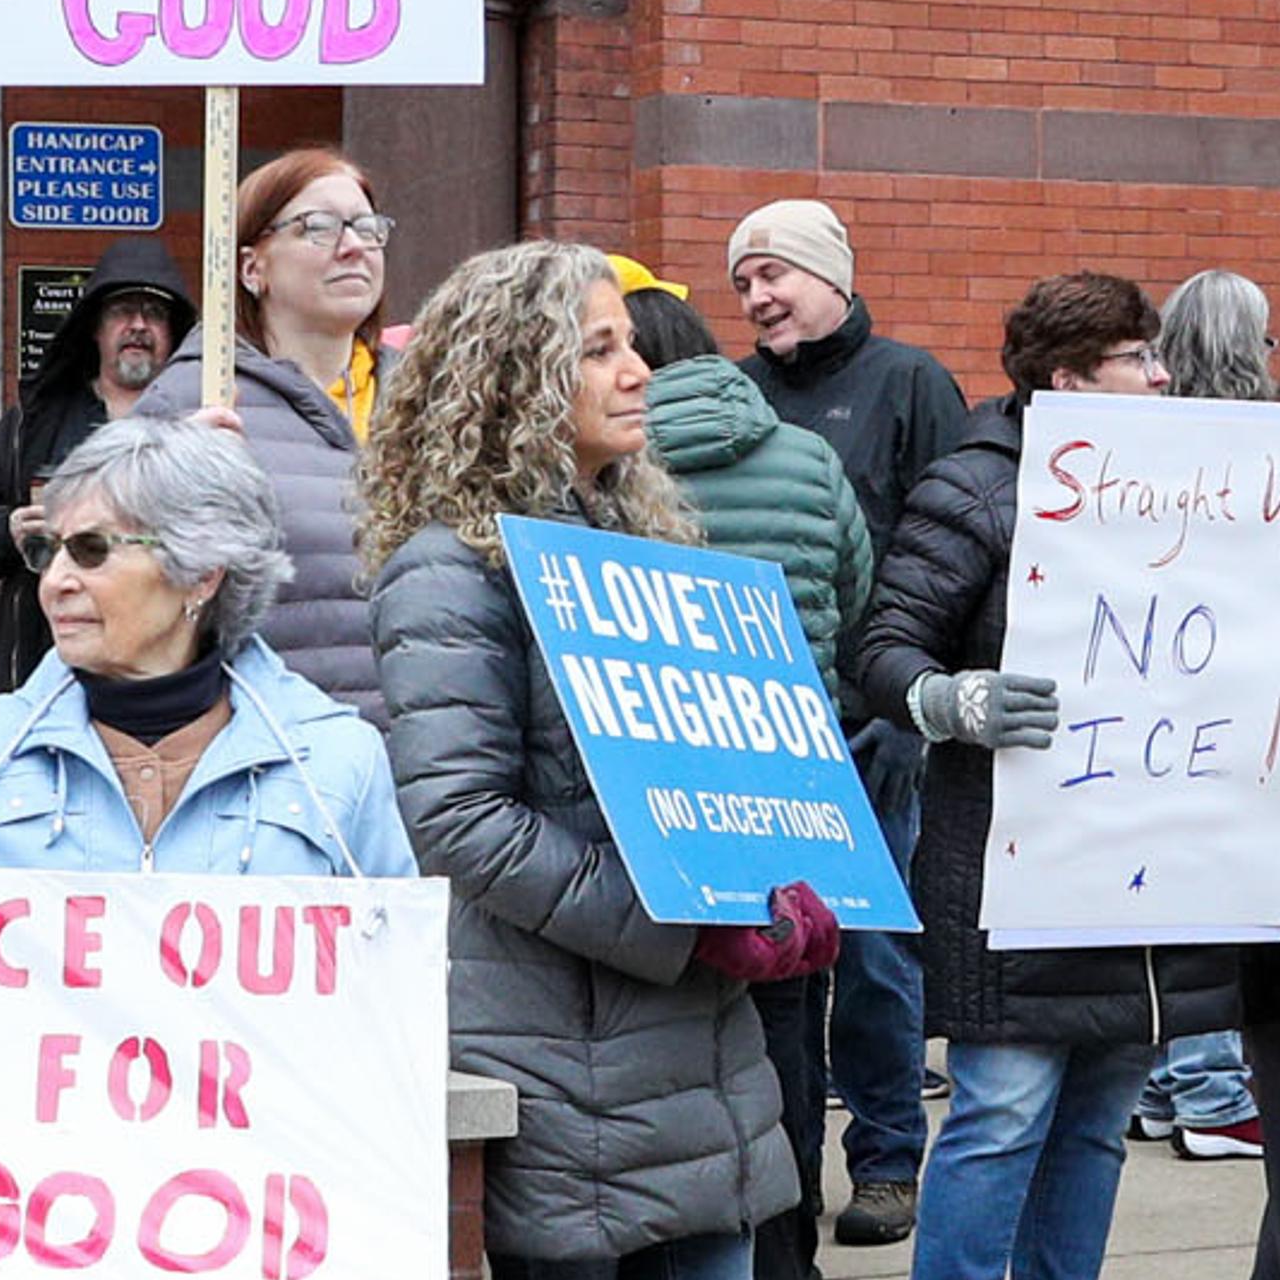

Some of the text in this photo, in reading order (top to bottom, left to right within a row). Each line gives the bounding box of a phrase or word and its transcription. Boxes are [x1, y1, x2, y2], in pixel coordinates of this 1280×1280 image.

[15, 156, 136, 175] ENTRANCE
[27, 131, 145, 151] HANDICAP
[17, 180, 155, 199] PLEASE USE
[22, 204, 150, 223] SIDE DOOR
[38, 285, 74, 298] Court
[1033, 439, 1237, 568] Straight
[1083, 593, 1218, 687] NO
[560, 653, 845, 764] NEIGHBOR
[645, 787, 856, 851] (NO EXCEPTIONS)
[159, 900, 353, 996] OUT
[35, 1033, 254, 1130] FOR
